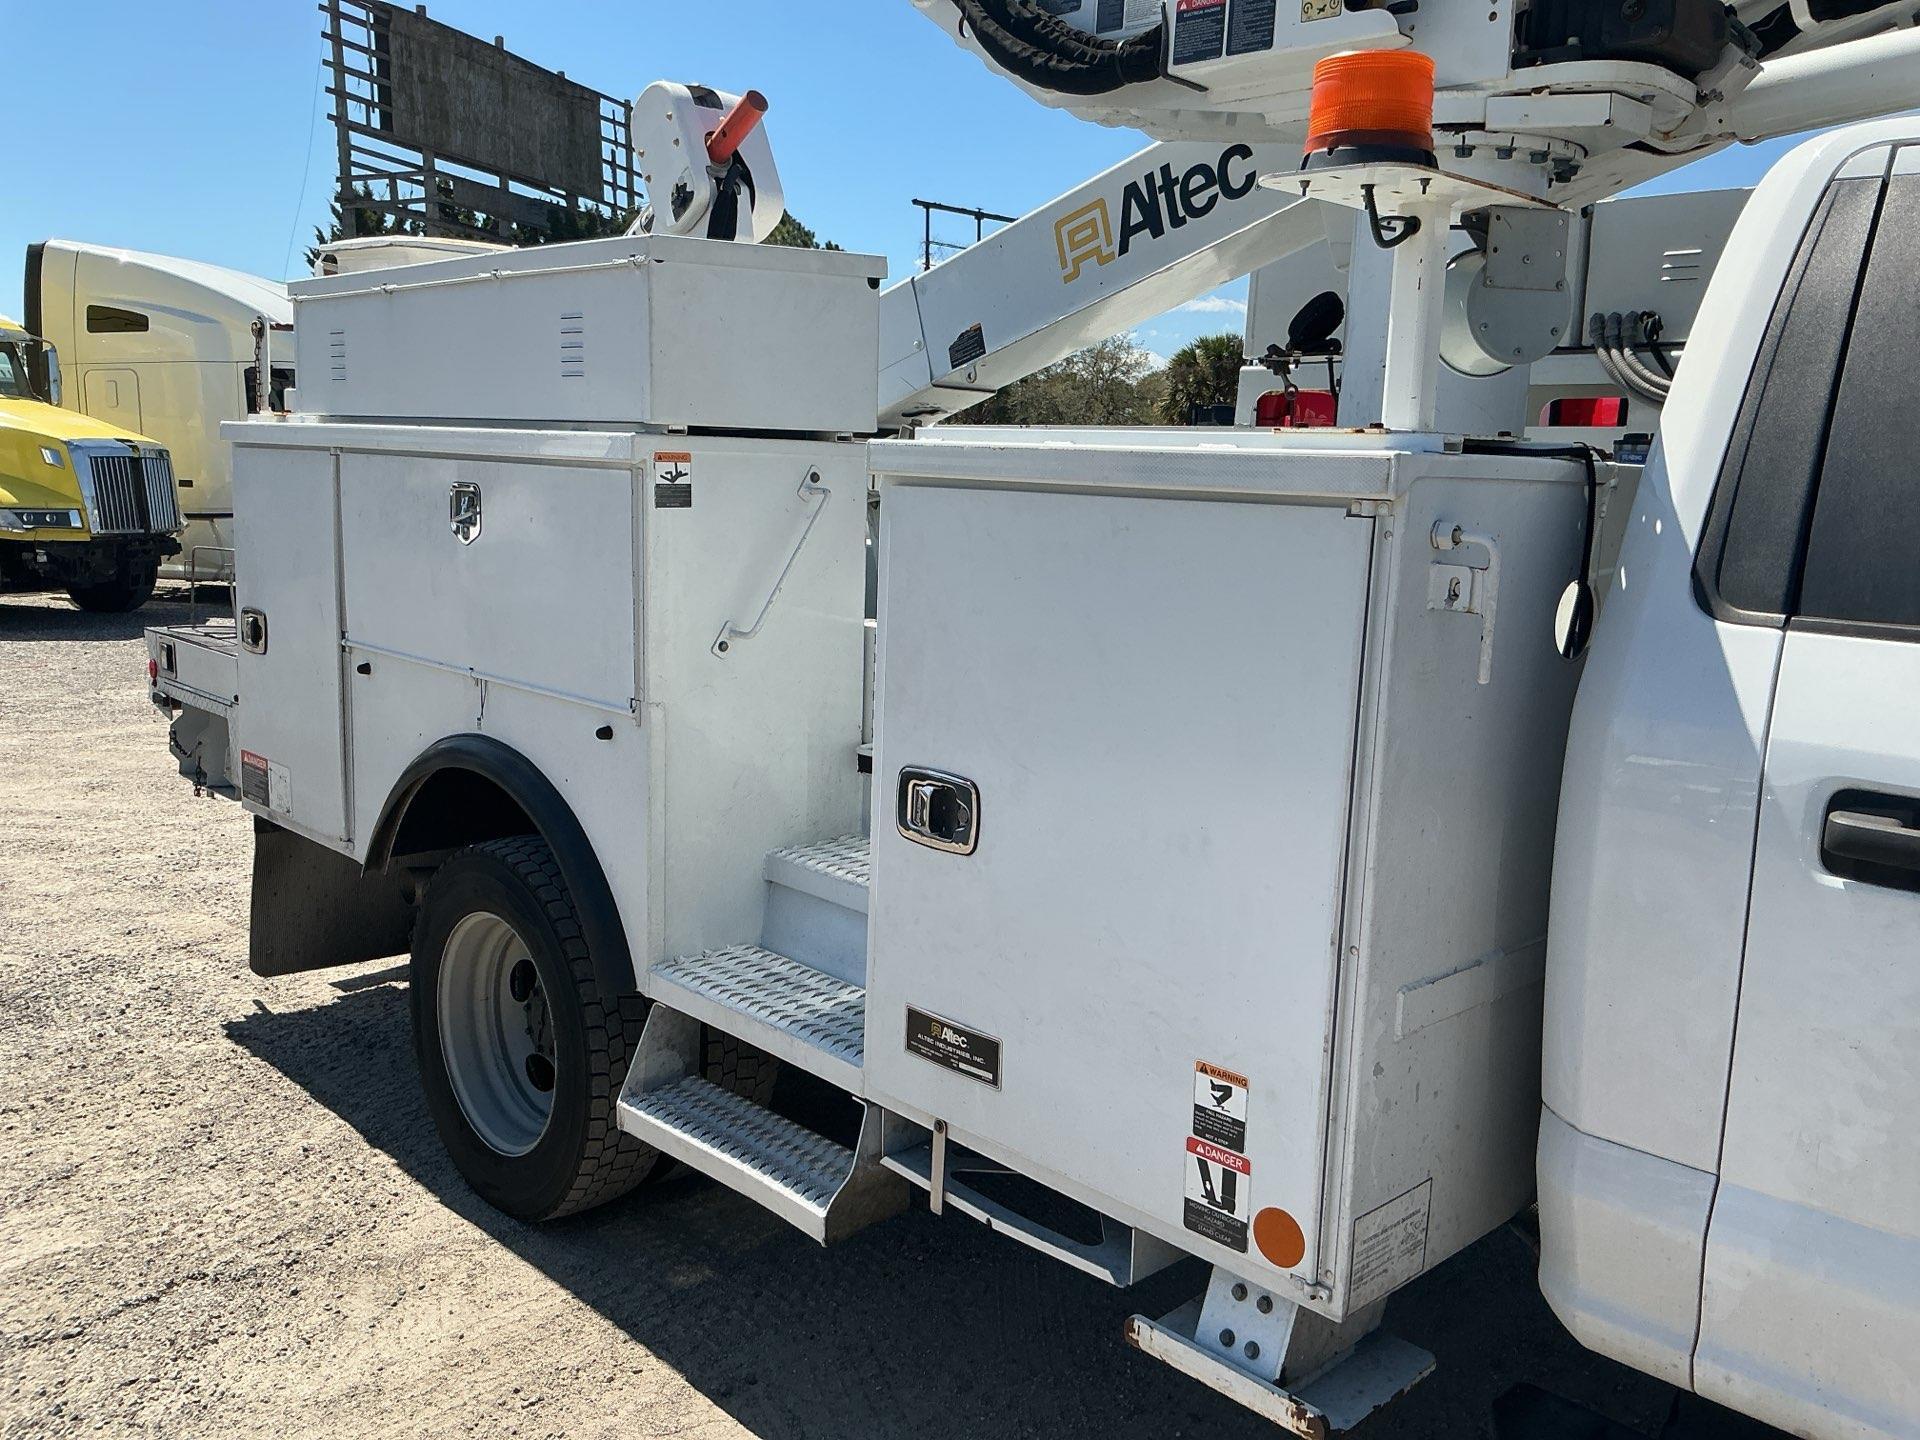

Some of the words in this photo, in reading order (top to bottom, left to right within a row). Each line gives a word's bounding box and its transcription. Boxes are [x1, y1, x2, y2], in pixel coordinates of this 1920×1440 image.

[1118, 143, 1257, 257] Altec
[918, 1033, 934, 1045] ALTEC
[973, 1055, 986, 1065] INC.
[941, 1027, 968, 1048] Altec
[1210, 1067, 1248, 1087] WARNING
[1205, 1146, 1243, 1170] DANGER
